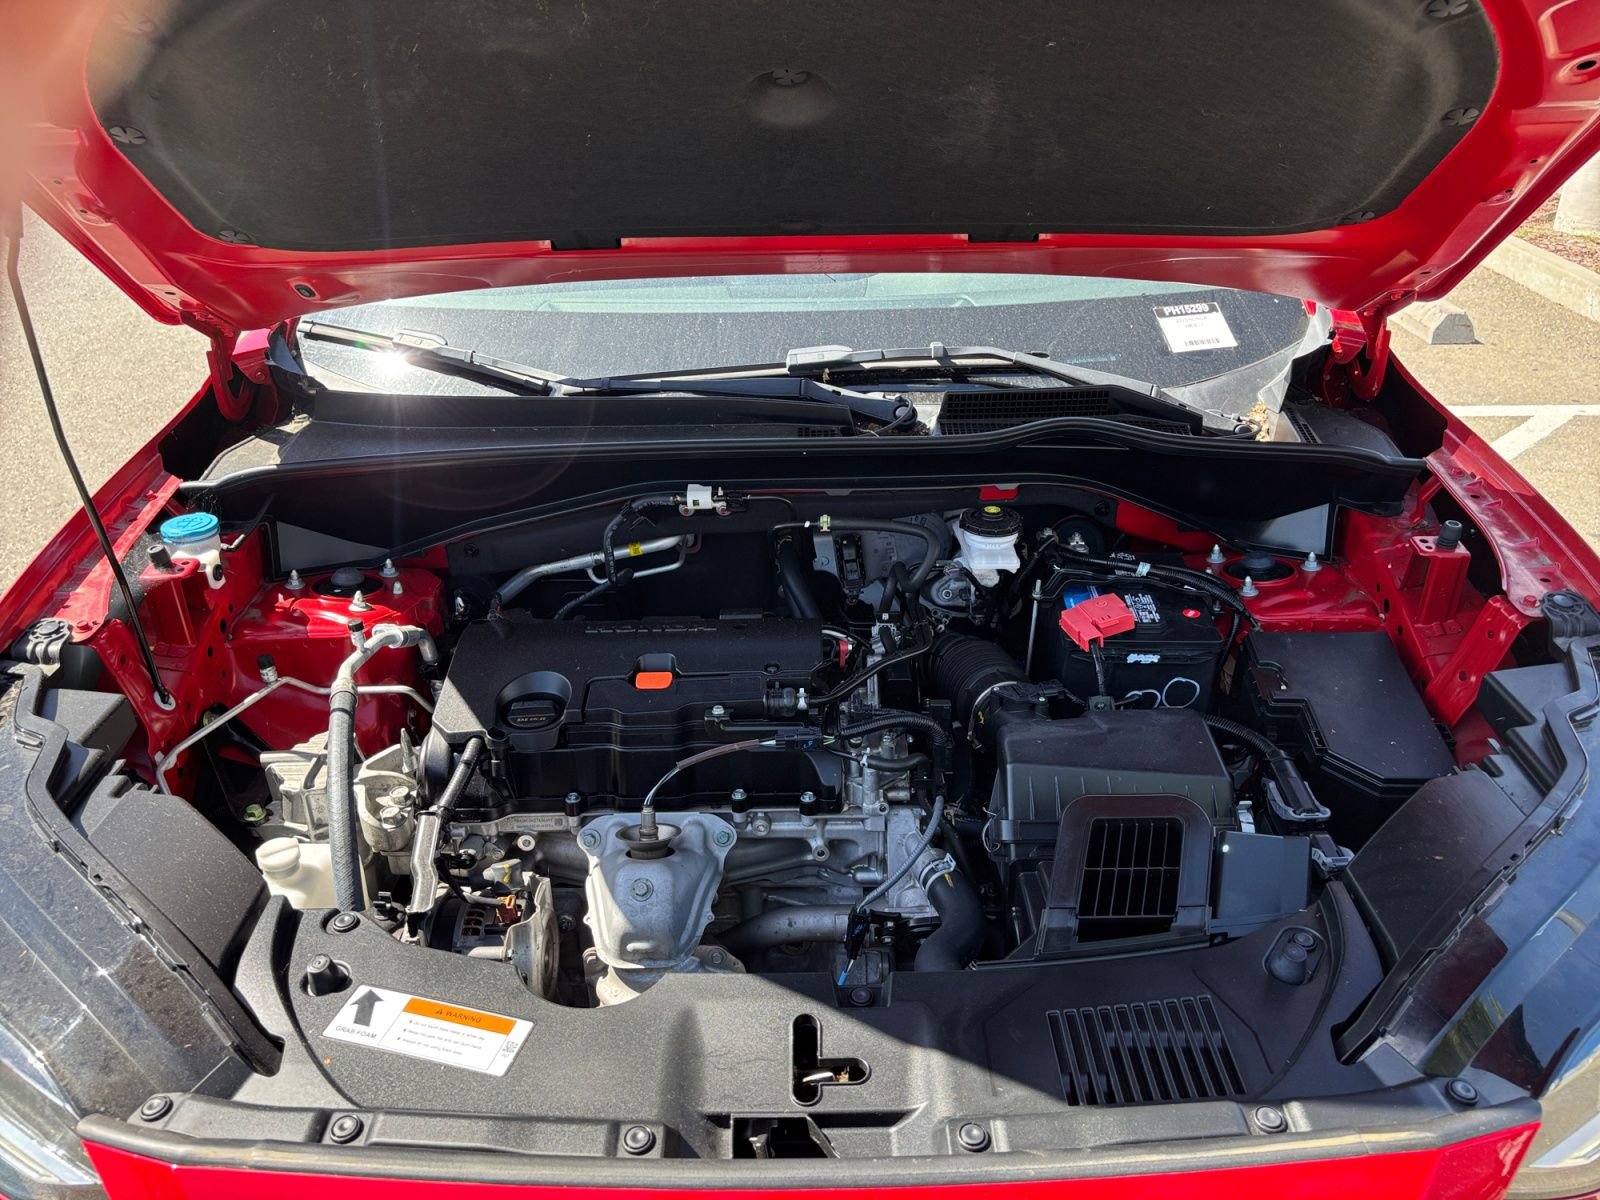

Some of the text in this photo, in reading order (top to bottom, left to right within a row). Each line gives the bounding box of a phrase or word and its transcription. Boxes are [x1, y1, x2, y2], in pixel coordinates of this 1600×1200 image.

[1163, 303, 1209, 316] PH15299
[446, 1011, 482, 1024] WARNING
[335, 1025, 377, 1039] GRAB FOAM
